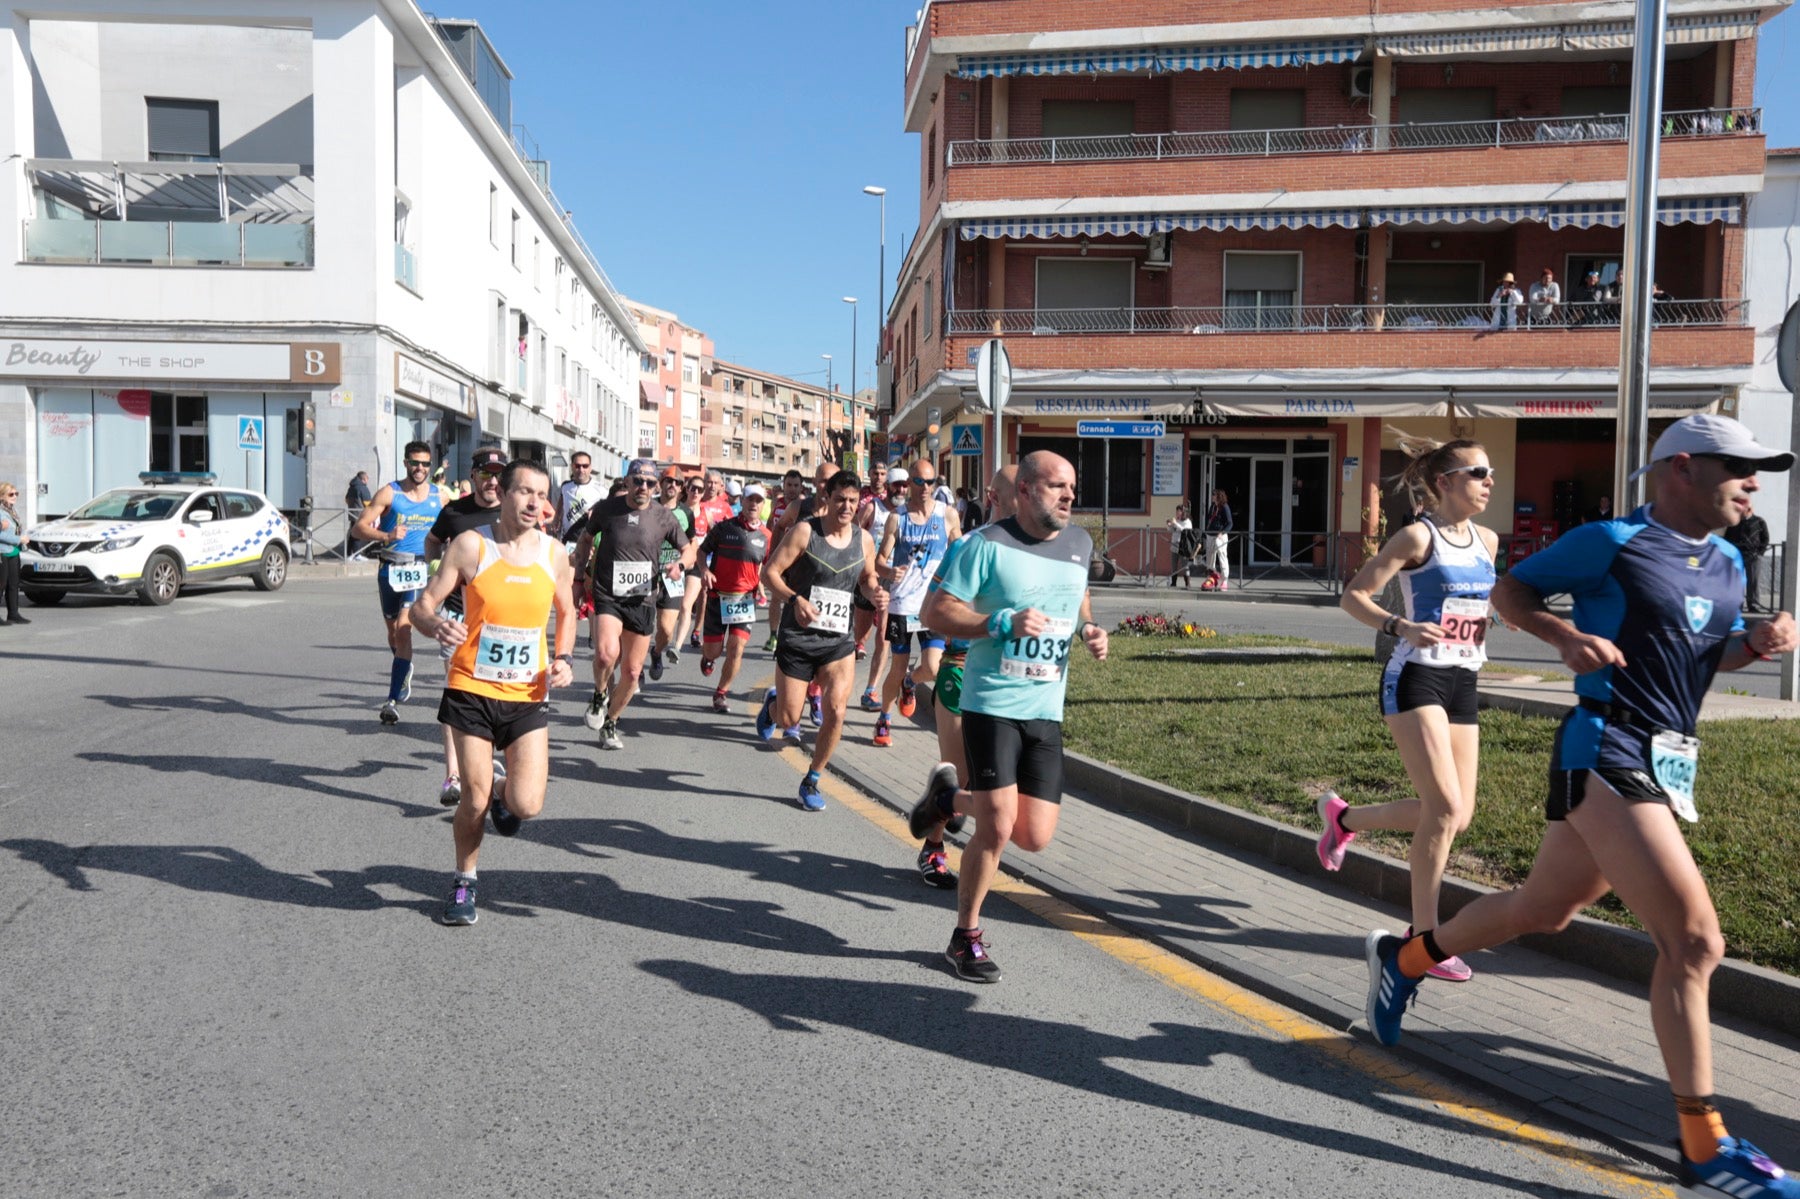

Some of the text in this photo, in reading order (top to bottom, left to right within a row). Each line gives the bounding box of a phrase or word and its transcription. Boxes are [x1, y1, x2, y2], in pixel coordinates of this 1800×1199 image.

[6, 343, 205, 373] Beauty THE SHOP
[304, 350, 326, 375] B
[1035, 398, 1151, 412] RESTAURANTE
[1285, 399, 1356, 413] PARADA
[1080, 425, 1115, 433] Granada
[397, 570, 421, 582] 183
[618, 573, 649, 584] 3008
[1441, 582, 1491, 591] TODO SUM
[726, 603, 749, 615] 628
[815, 600, 848, 618] 3122
[489, 643, 530, 665] 515
[1010, 637, 1067, 661] 1033
